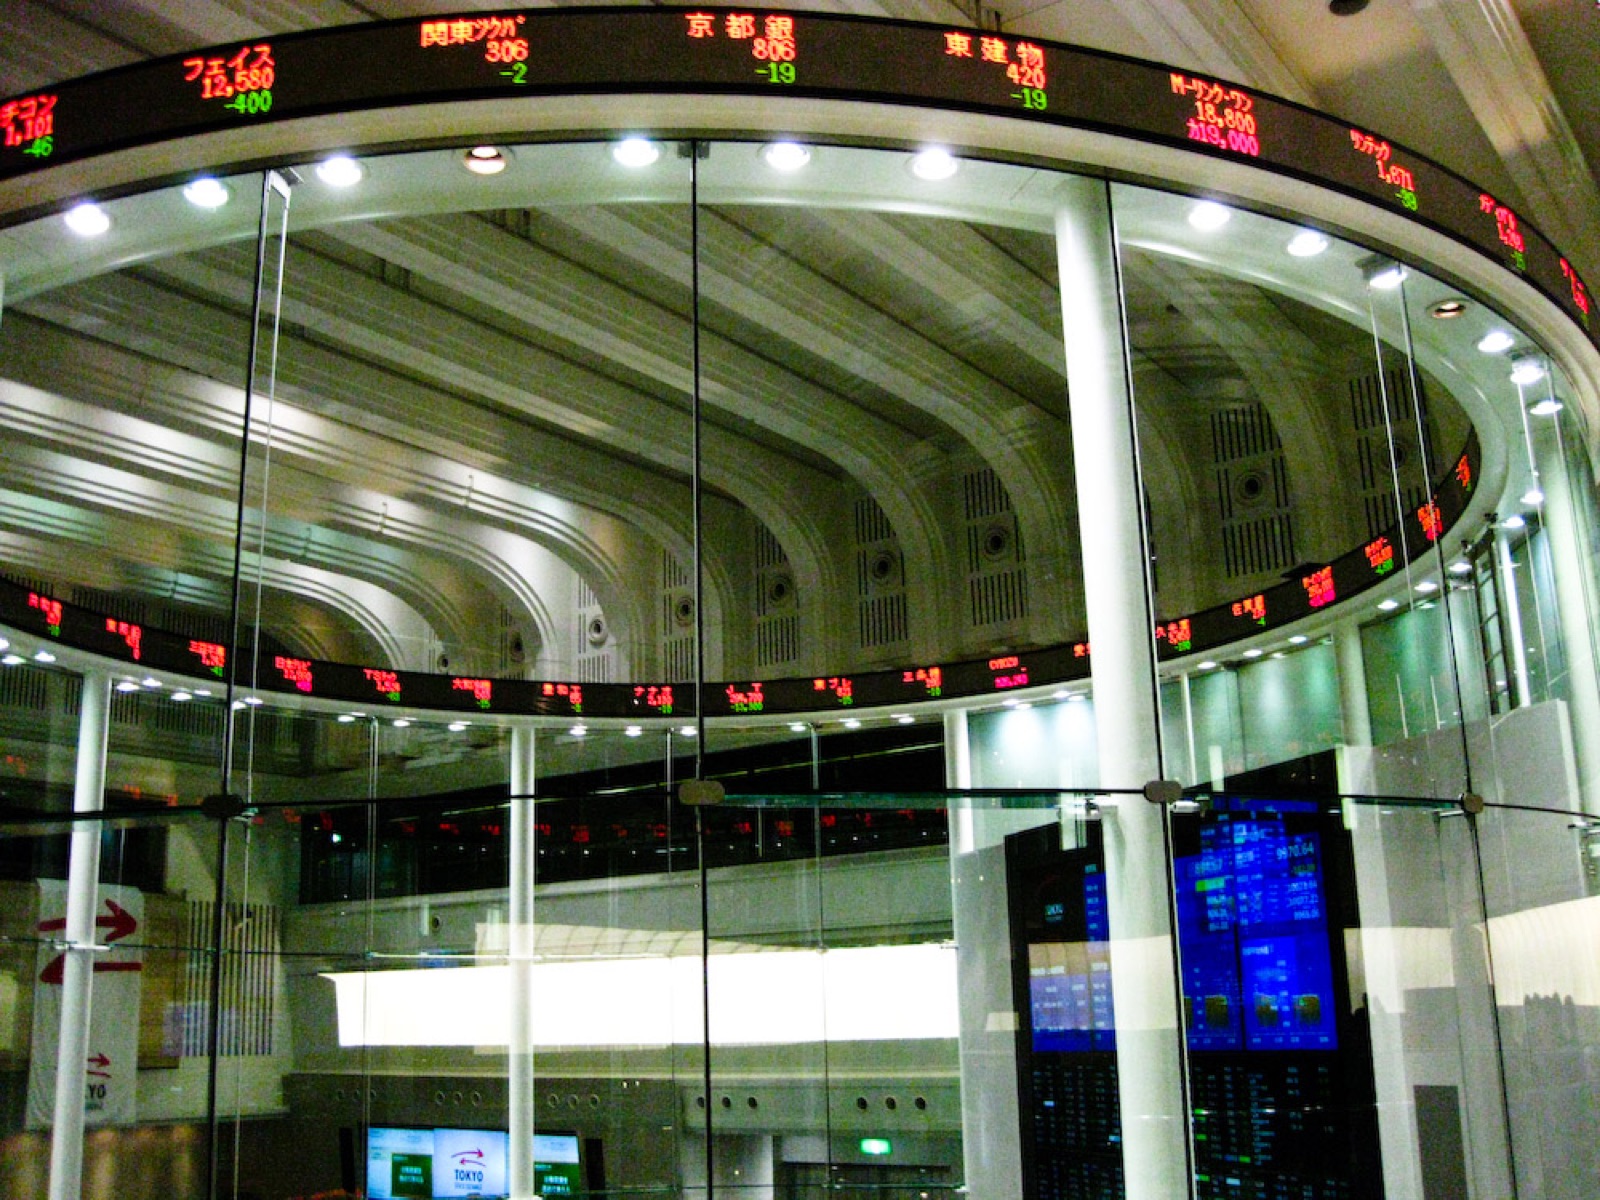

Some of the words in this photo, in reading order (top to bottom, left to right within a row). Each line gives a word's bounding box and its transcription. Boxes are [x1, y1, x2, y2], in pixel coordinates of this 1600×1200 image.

[485, 38, 528, 62] 306
[752, 38, 795, 62] 806
[183, 44, 275, 81] フェイス
[500, 62, 527, 84] -2
[755, 62, 796, 84] -19
[202, 67, 274, 99] 12,580
[1006, 63, 1045, 89] 420
[224, 89, 272, 114] -400
[1010, 88, 1047, 111] -19
[1195, 100, 1256, 135] 18,800
[454, 1168, 484, 1182] TOKYO
